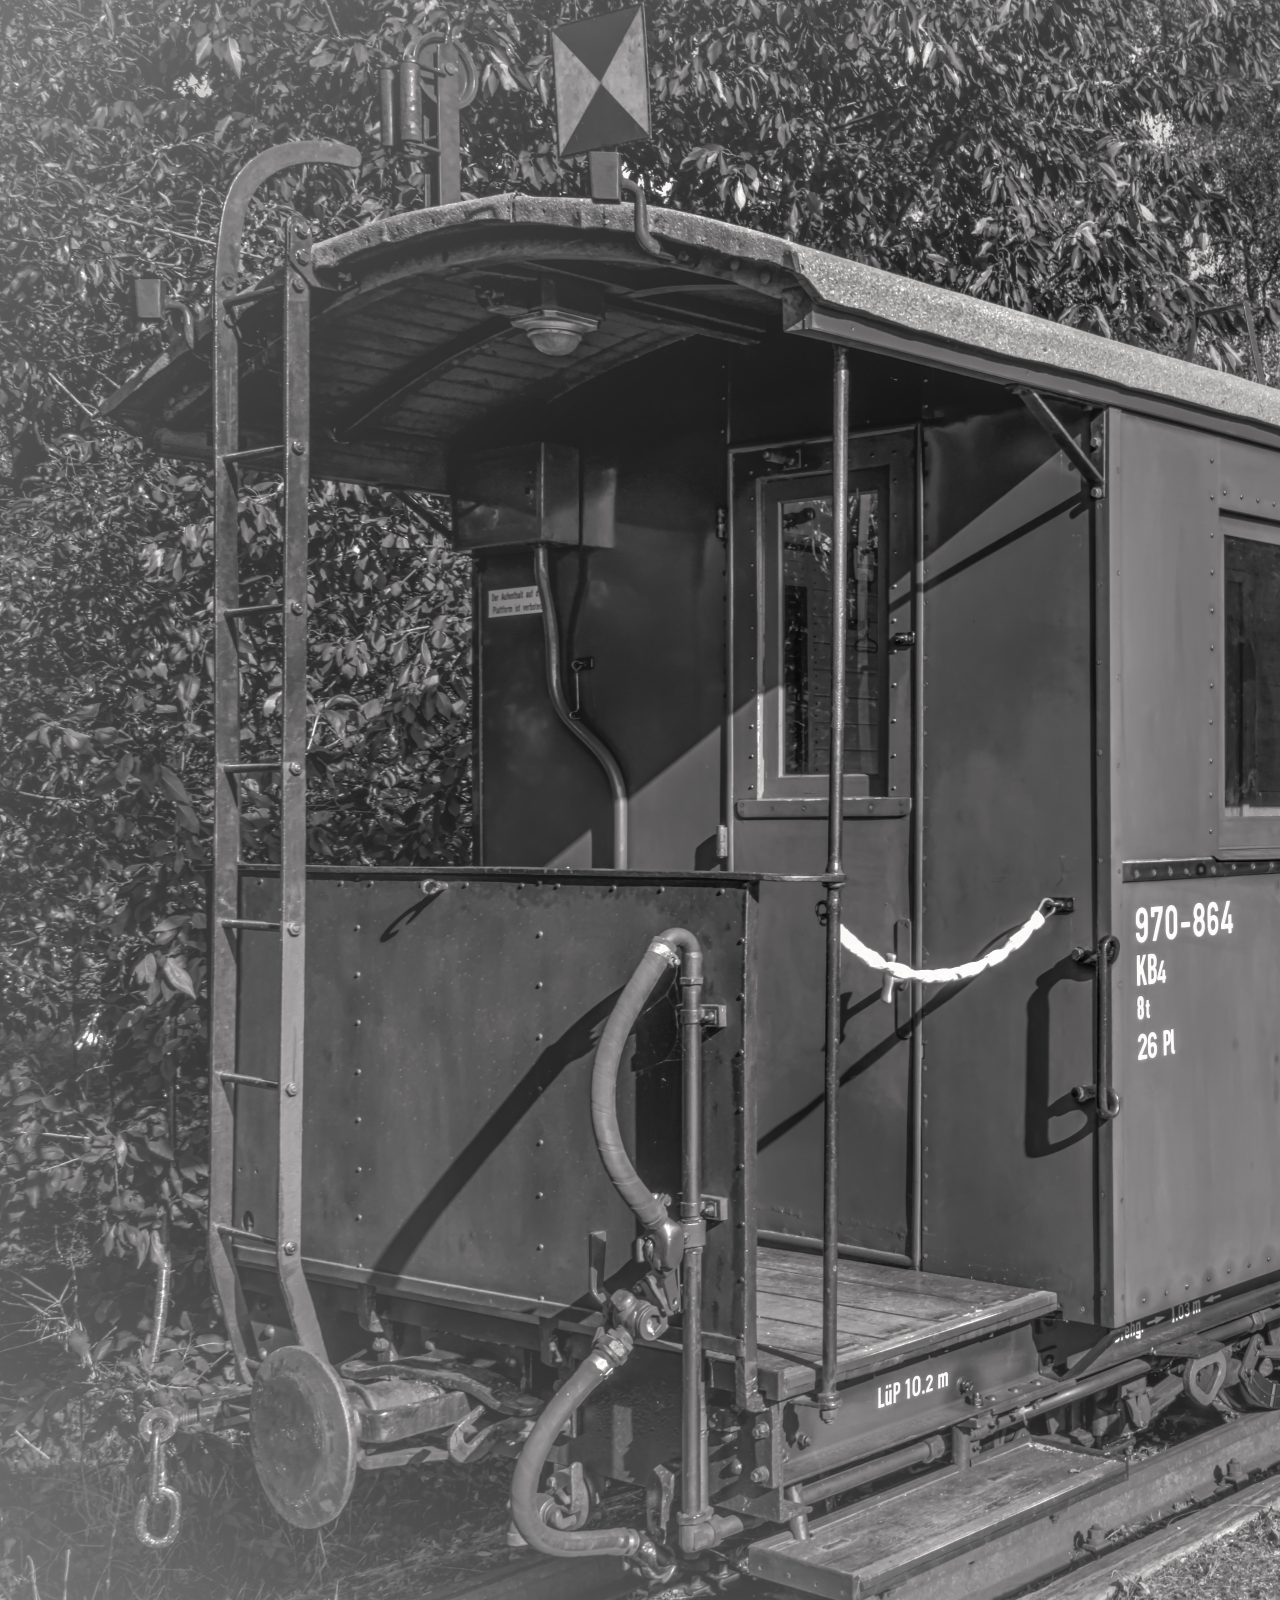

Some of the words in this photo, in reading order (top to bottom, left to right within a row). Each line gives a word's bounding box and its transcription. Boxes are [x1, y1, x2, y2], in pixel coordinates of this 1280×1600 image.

[1135, 900, 1234, 944] 970-864
[1136, 953, 1167, 987] KB4
[1136, 995, 1151, 1021] 8t
[1137, 1031, 1158, 1061] 26
[1163, 1028, 1176, 1056] Pl
[1171, 1302, 1190, 1323] 1.03
[1192, 1300, 1201, 1315] m
[877, 1381, 901, 1409] LüP
[905, 1375, 934, 1400] 10.2
[937, 1371, 949, 1389] m
